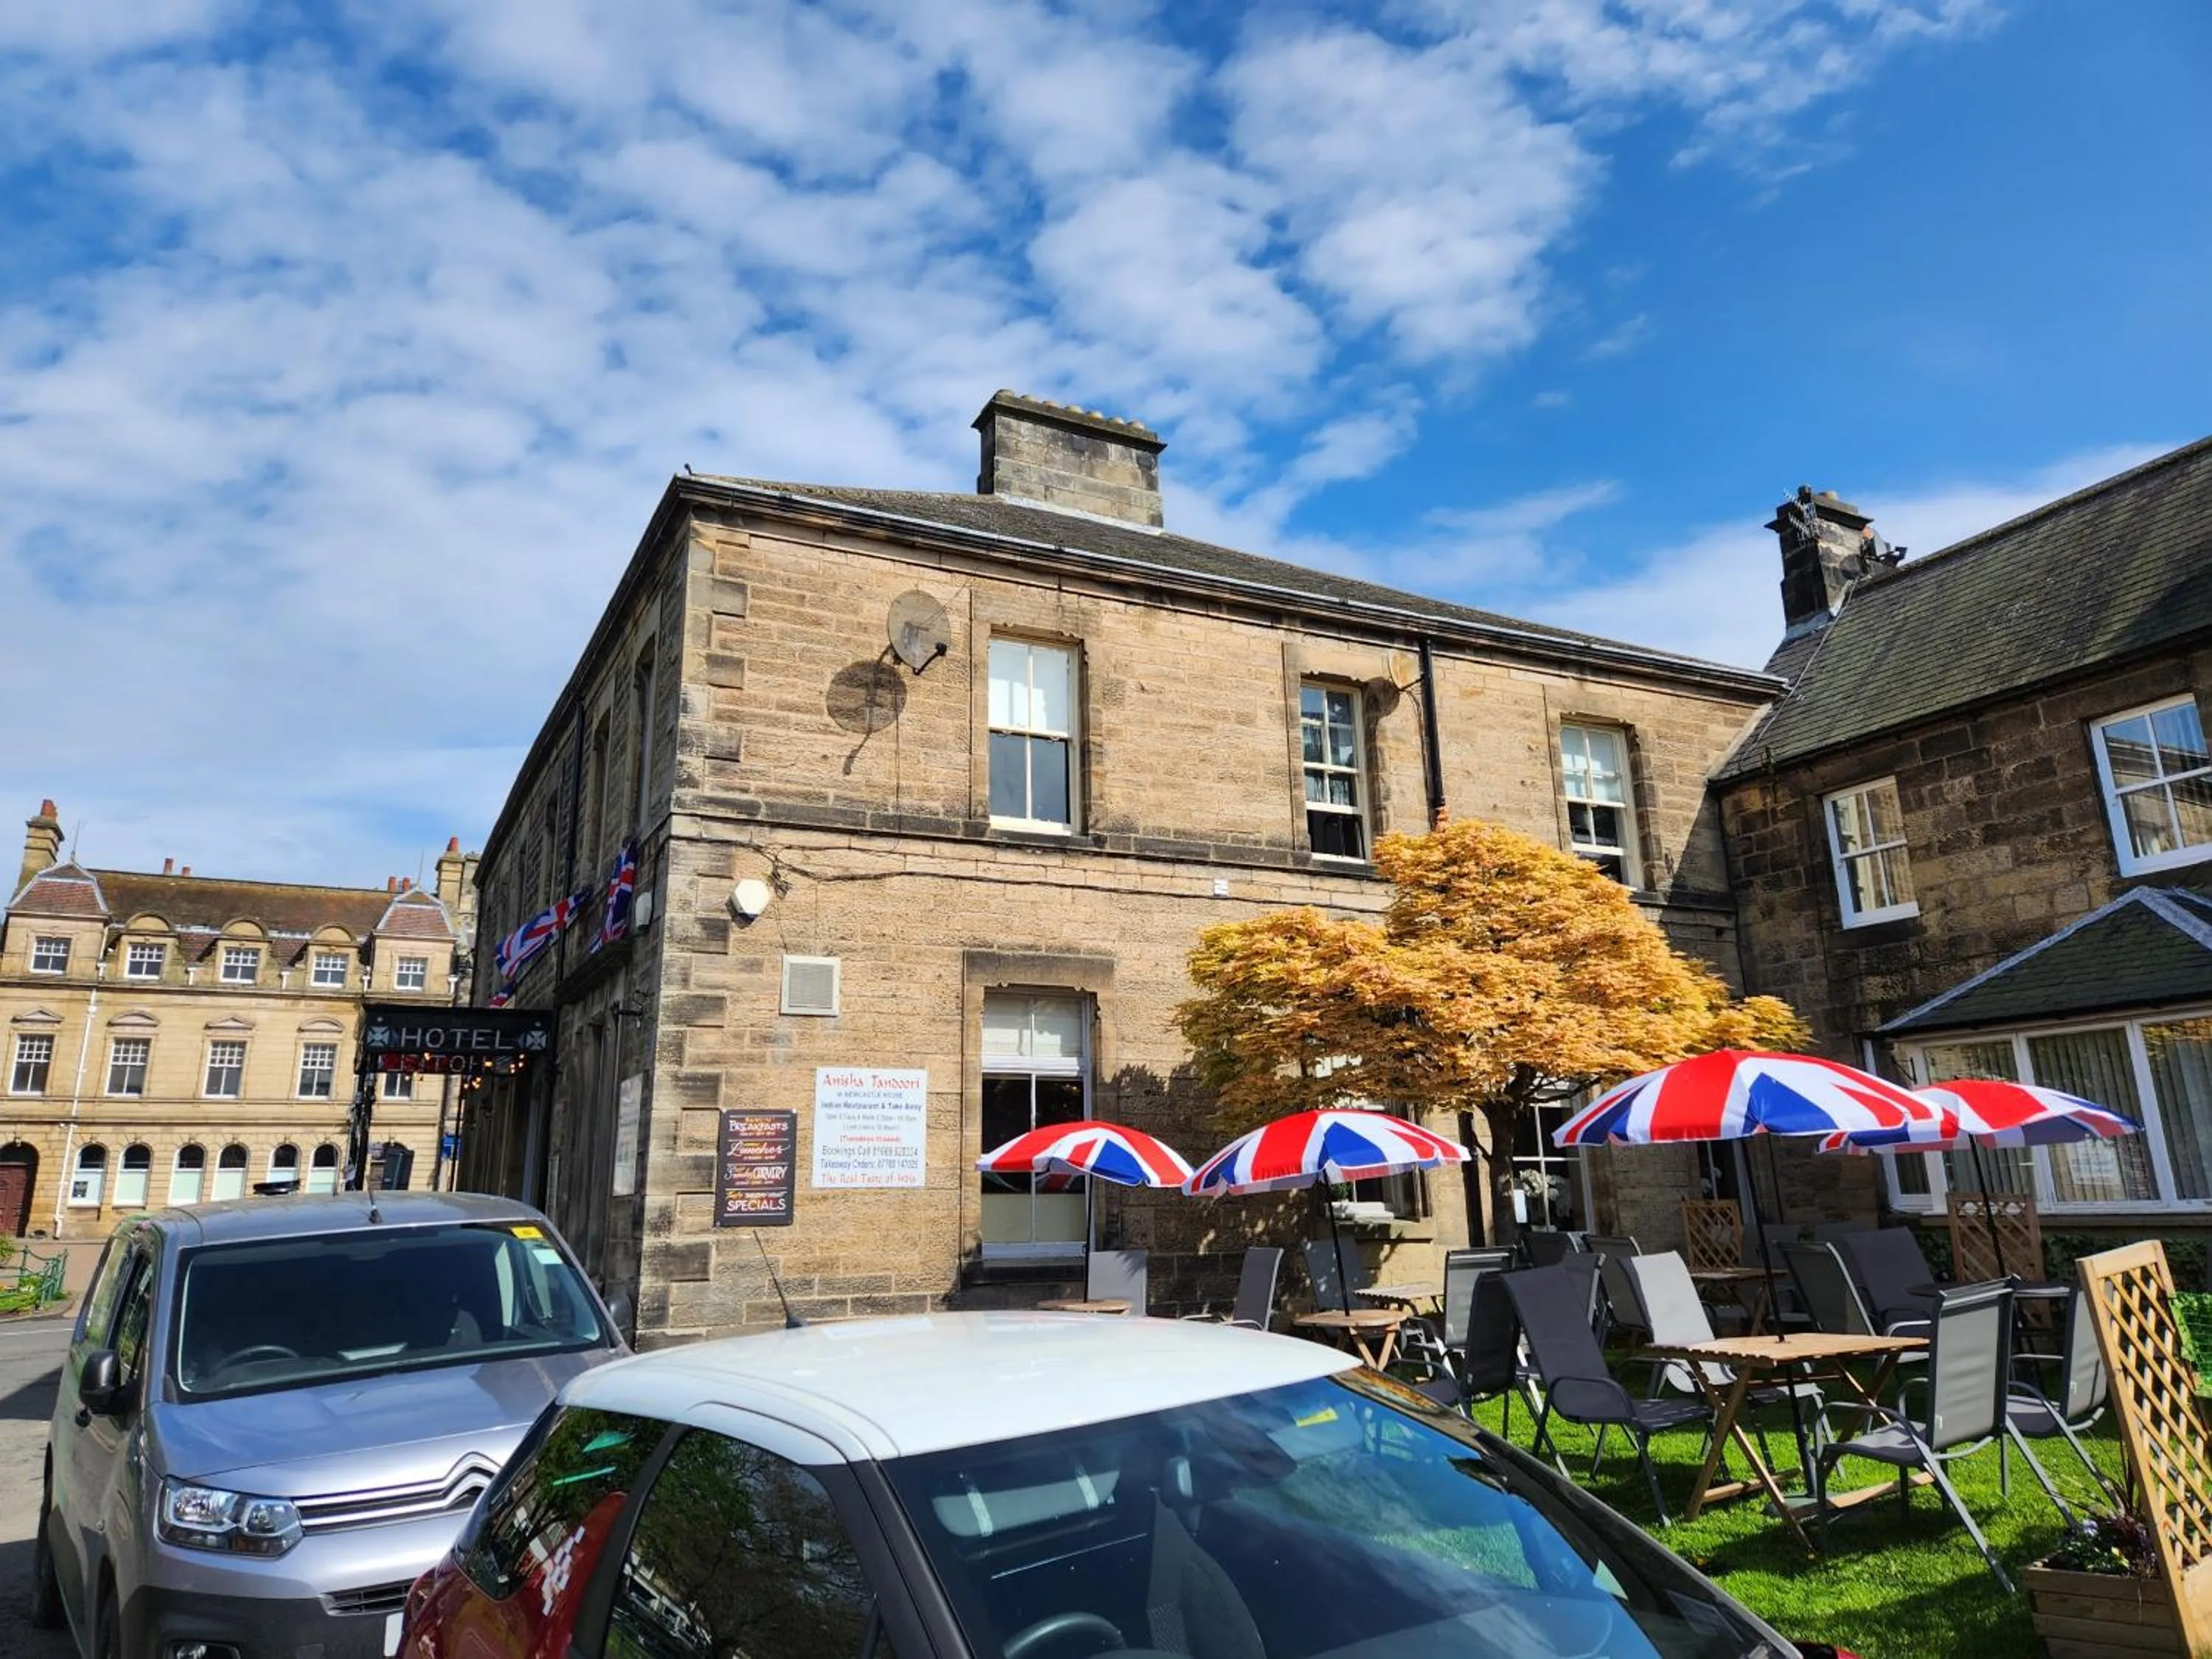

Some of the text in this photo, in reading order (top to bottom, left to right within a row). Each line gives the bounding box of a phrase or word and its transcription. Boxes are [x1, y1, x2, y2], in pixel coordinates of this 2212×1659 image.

[400, 1027, 514, 1049] HOTEL
[823, 1074, 919, 1089] Anisha Tandoori
[822, 1145, 855, 1158] Bookings
[858, 1146, 870, 1155] Call
[821, 1158, 851, 1169] Takeaway
[727, 1199, 786, 1211] SPECIALS
